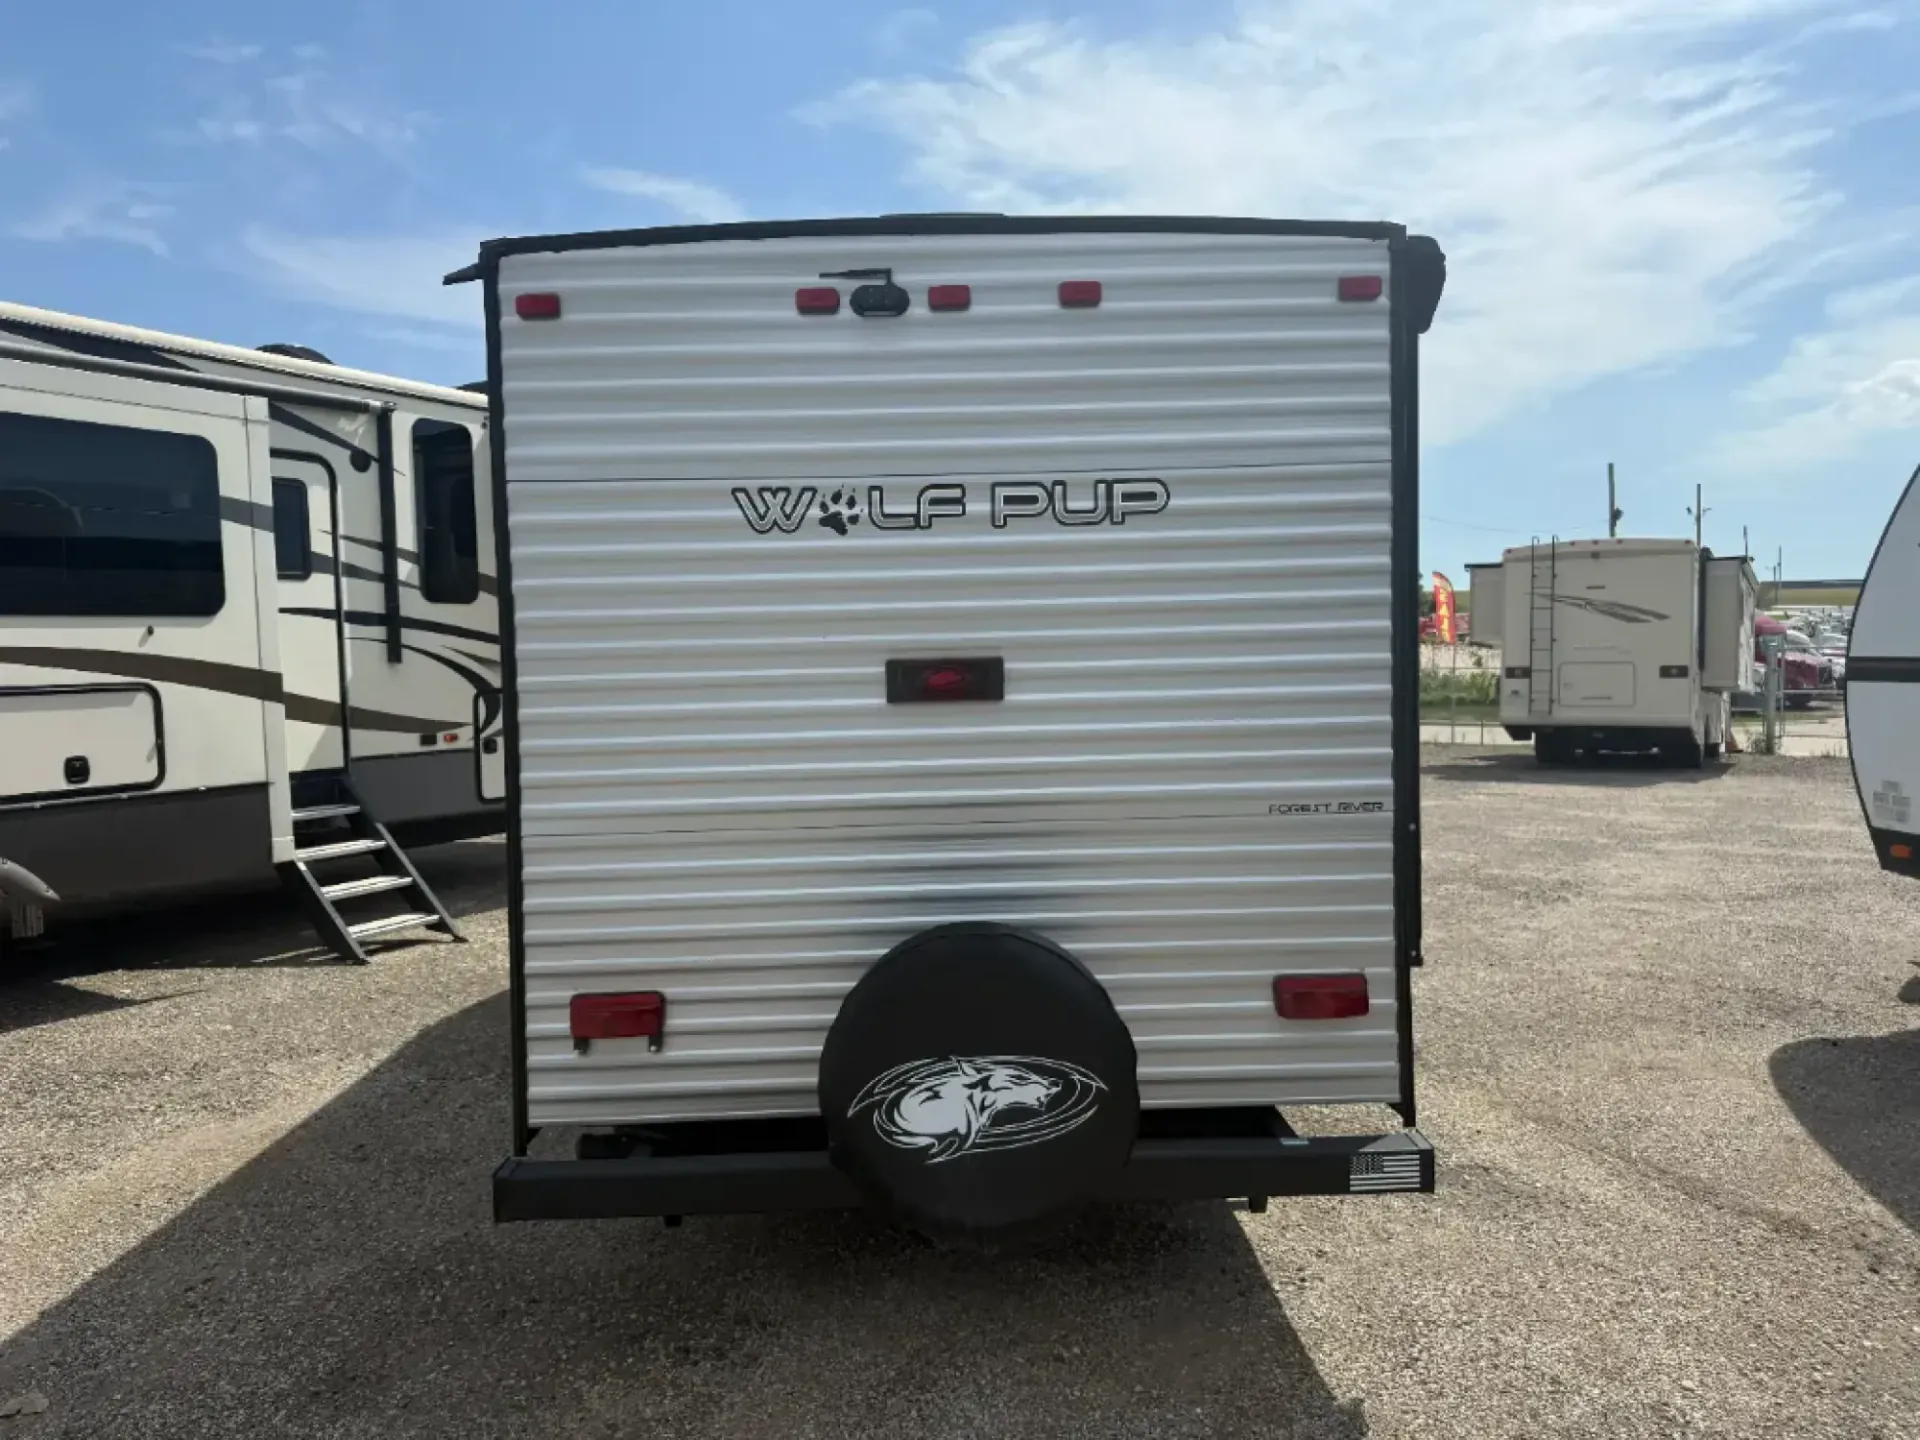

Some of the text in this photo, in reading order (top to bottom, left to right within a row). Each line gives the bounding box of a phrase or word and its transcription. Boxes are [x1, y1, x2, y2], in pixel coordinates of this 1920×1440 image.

[990, 478, 1171, 528] PUP
[1269, 801, 1384, 815] FOREST RIVER
